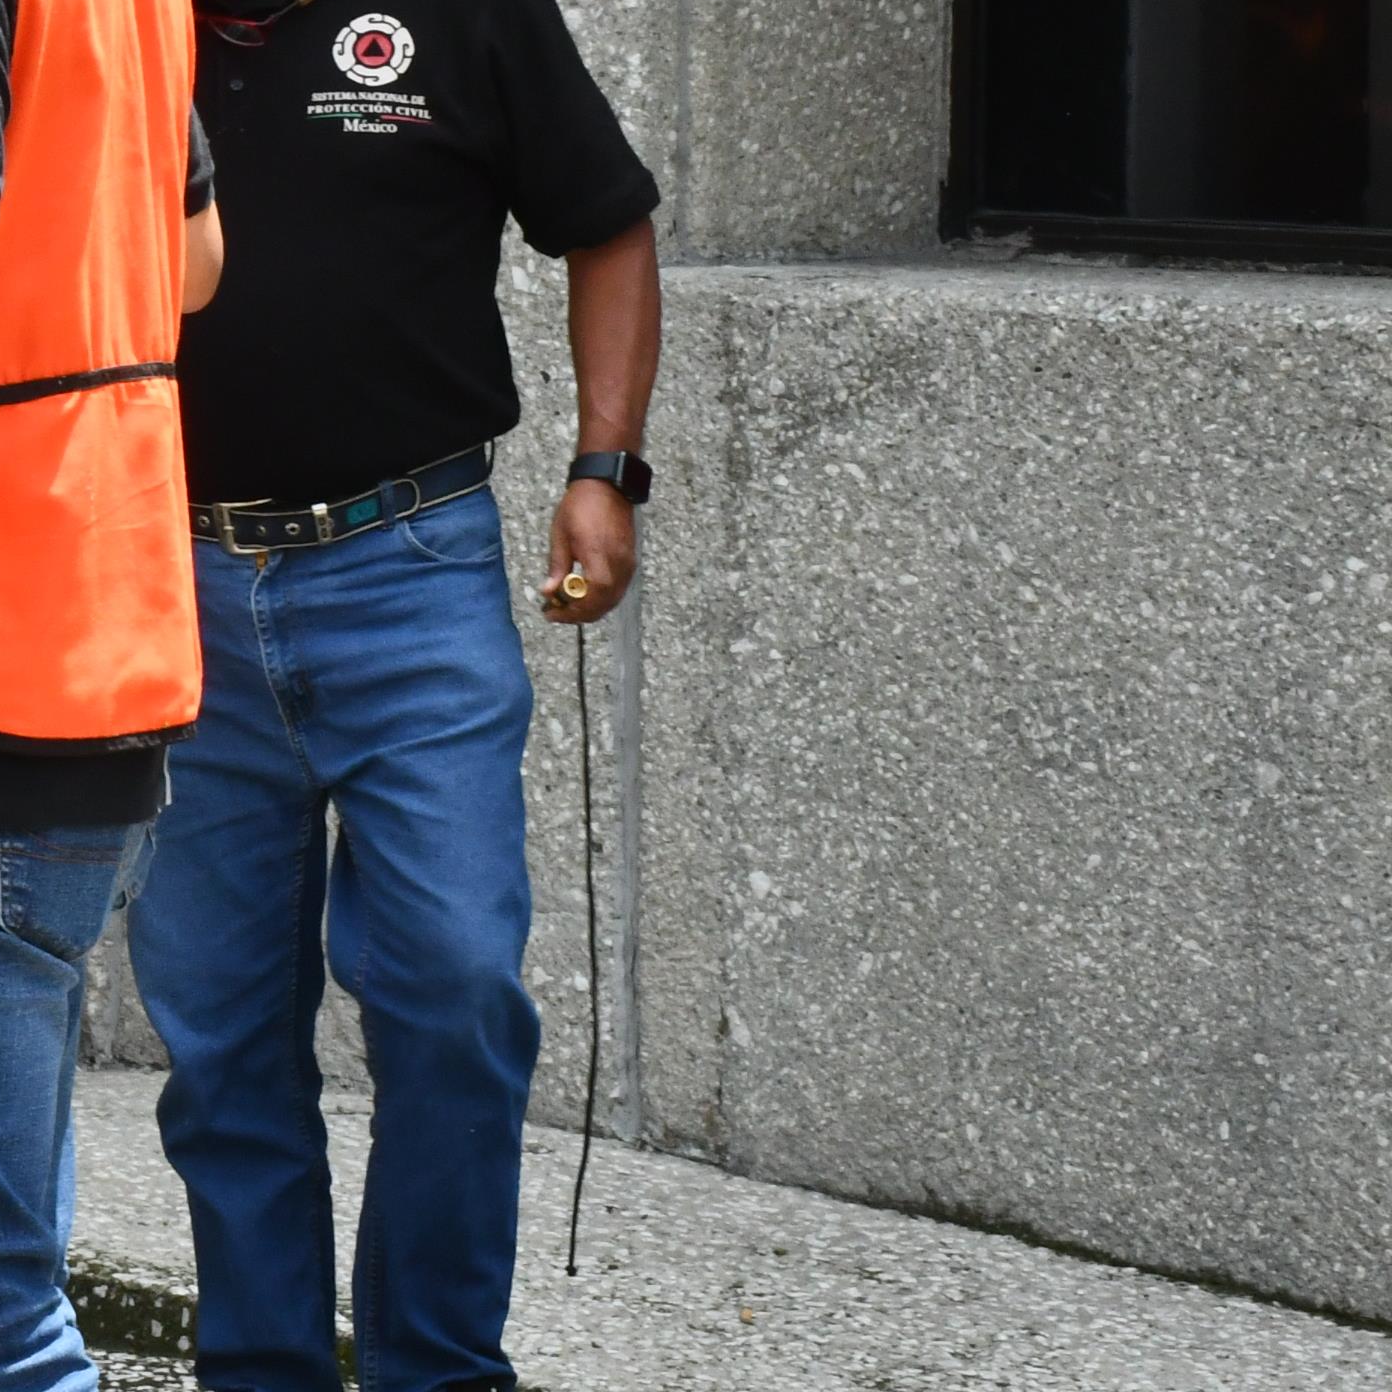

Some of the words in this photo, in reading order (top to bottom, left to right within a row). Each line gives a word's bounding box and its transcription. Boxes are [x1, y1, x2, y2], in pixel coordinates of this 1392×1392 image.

[311, 91, 357, 102] SISTEMA
[358, 91, 410, 104] NACIONAL
[410, 94, 426, 105] DE
[307, 101, 393, 114] PROTECCIÓN
[395, 105, 432, 119] CIVIL
[342, 118, 398, 133] México
